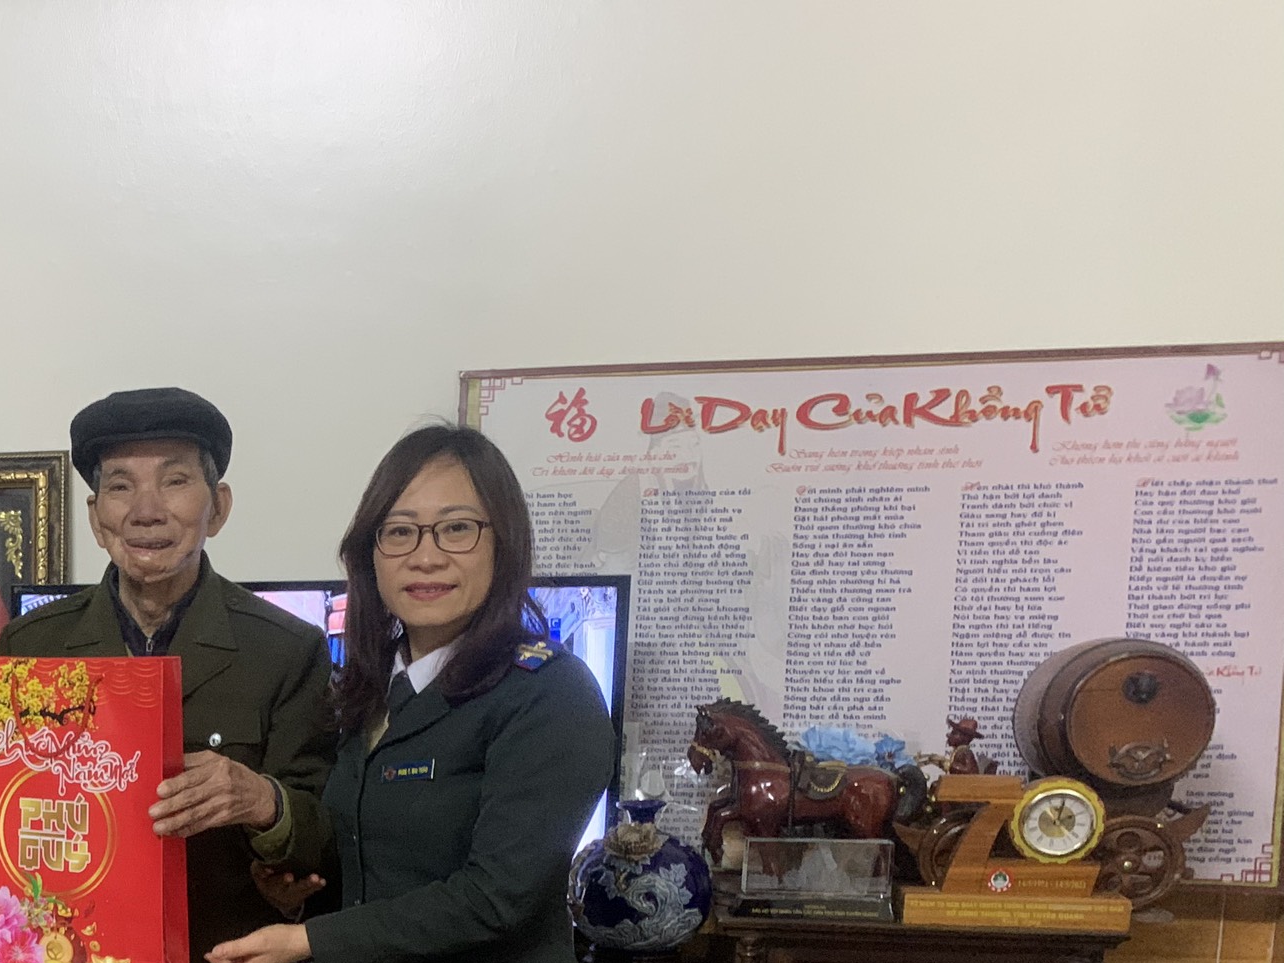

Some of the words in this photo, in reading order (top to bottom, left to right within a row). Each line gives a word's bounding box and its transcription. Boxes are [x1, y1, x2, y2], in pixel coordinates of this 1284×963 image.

[796, 392, 899, 431] Của
[902, 385, 1044, 453] Khổng
[1046, 383, 1114, 424] Tử
[20, 792, 89, 834] PHÚ
